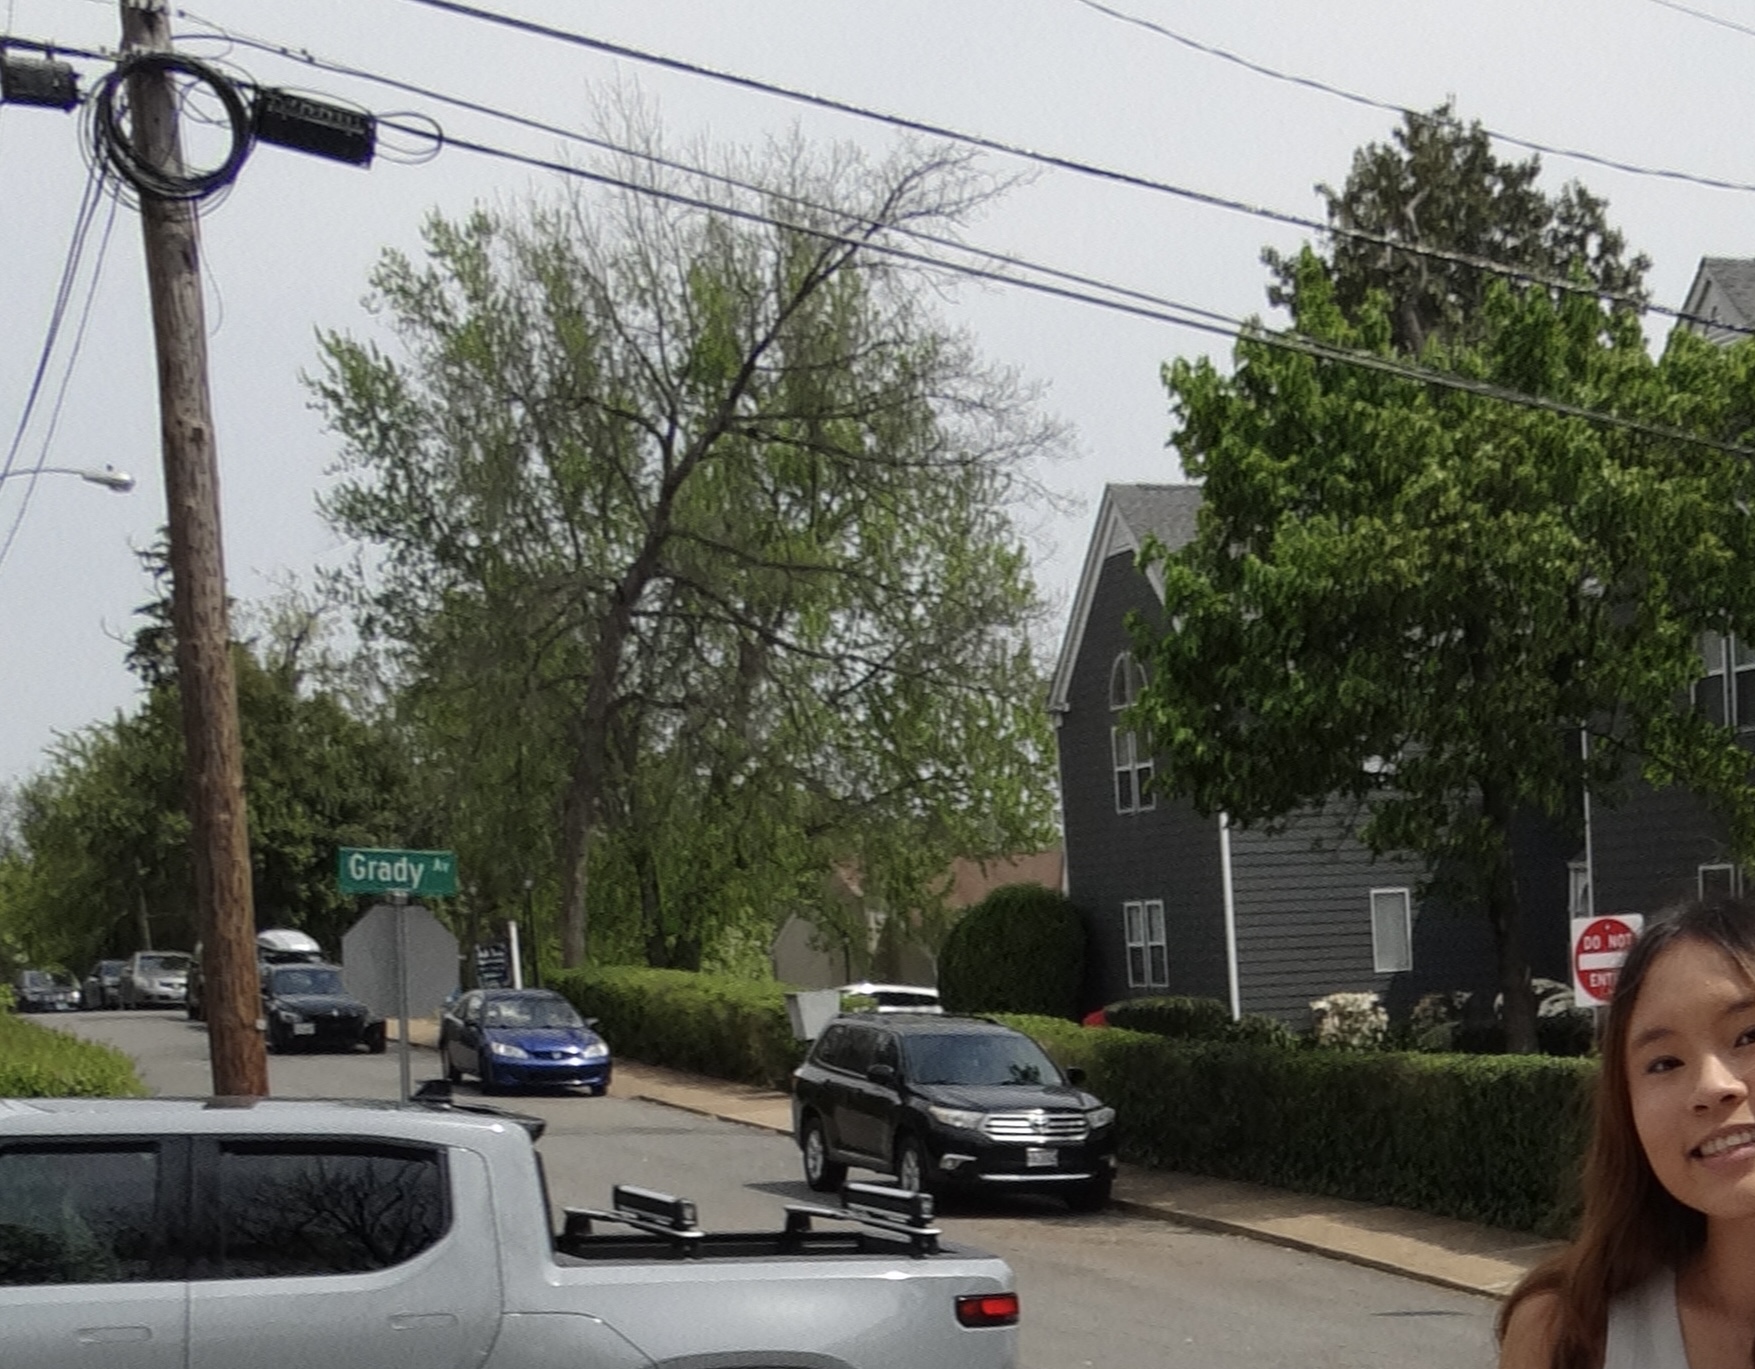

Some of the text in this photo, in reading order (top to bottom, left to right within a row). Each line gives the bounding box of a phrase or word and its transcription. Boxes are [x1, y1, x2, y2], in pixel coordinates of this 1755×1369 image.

[349, 853, 450, 889] Grady Av
[1583, 933, 1632, 950] DO NOT
[1588, 972, 1618, 988] ENT
